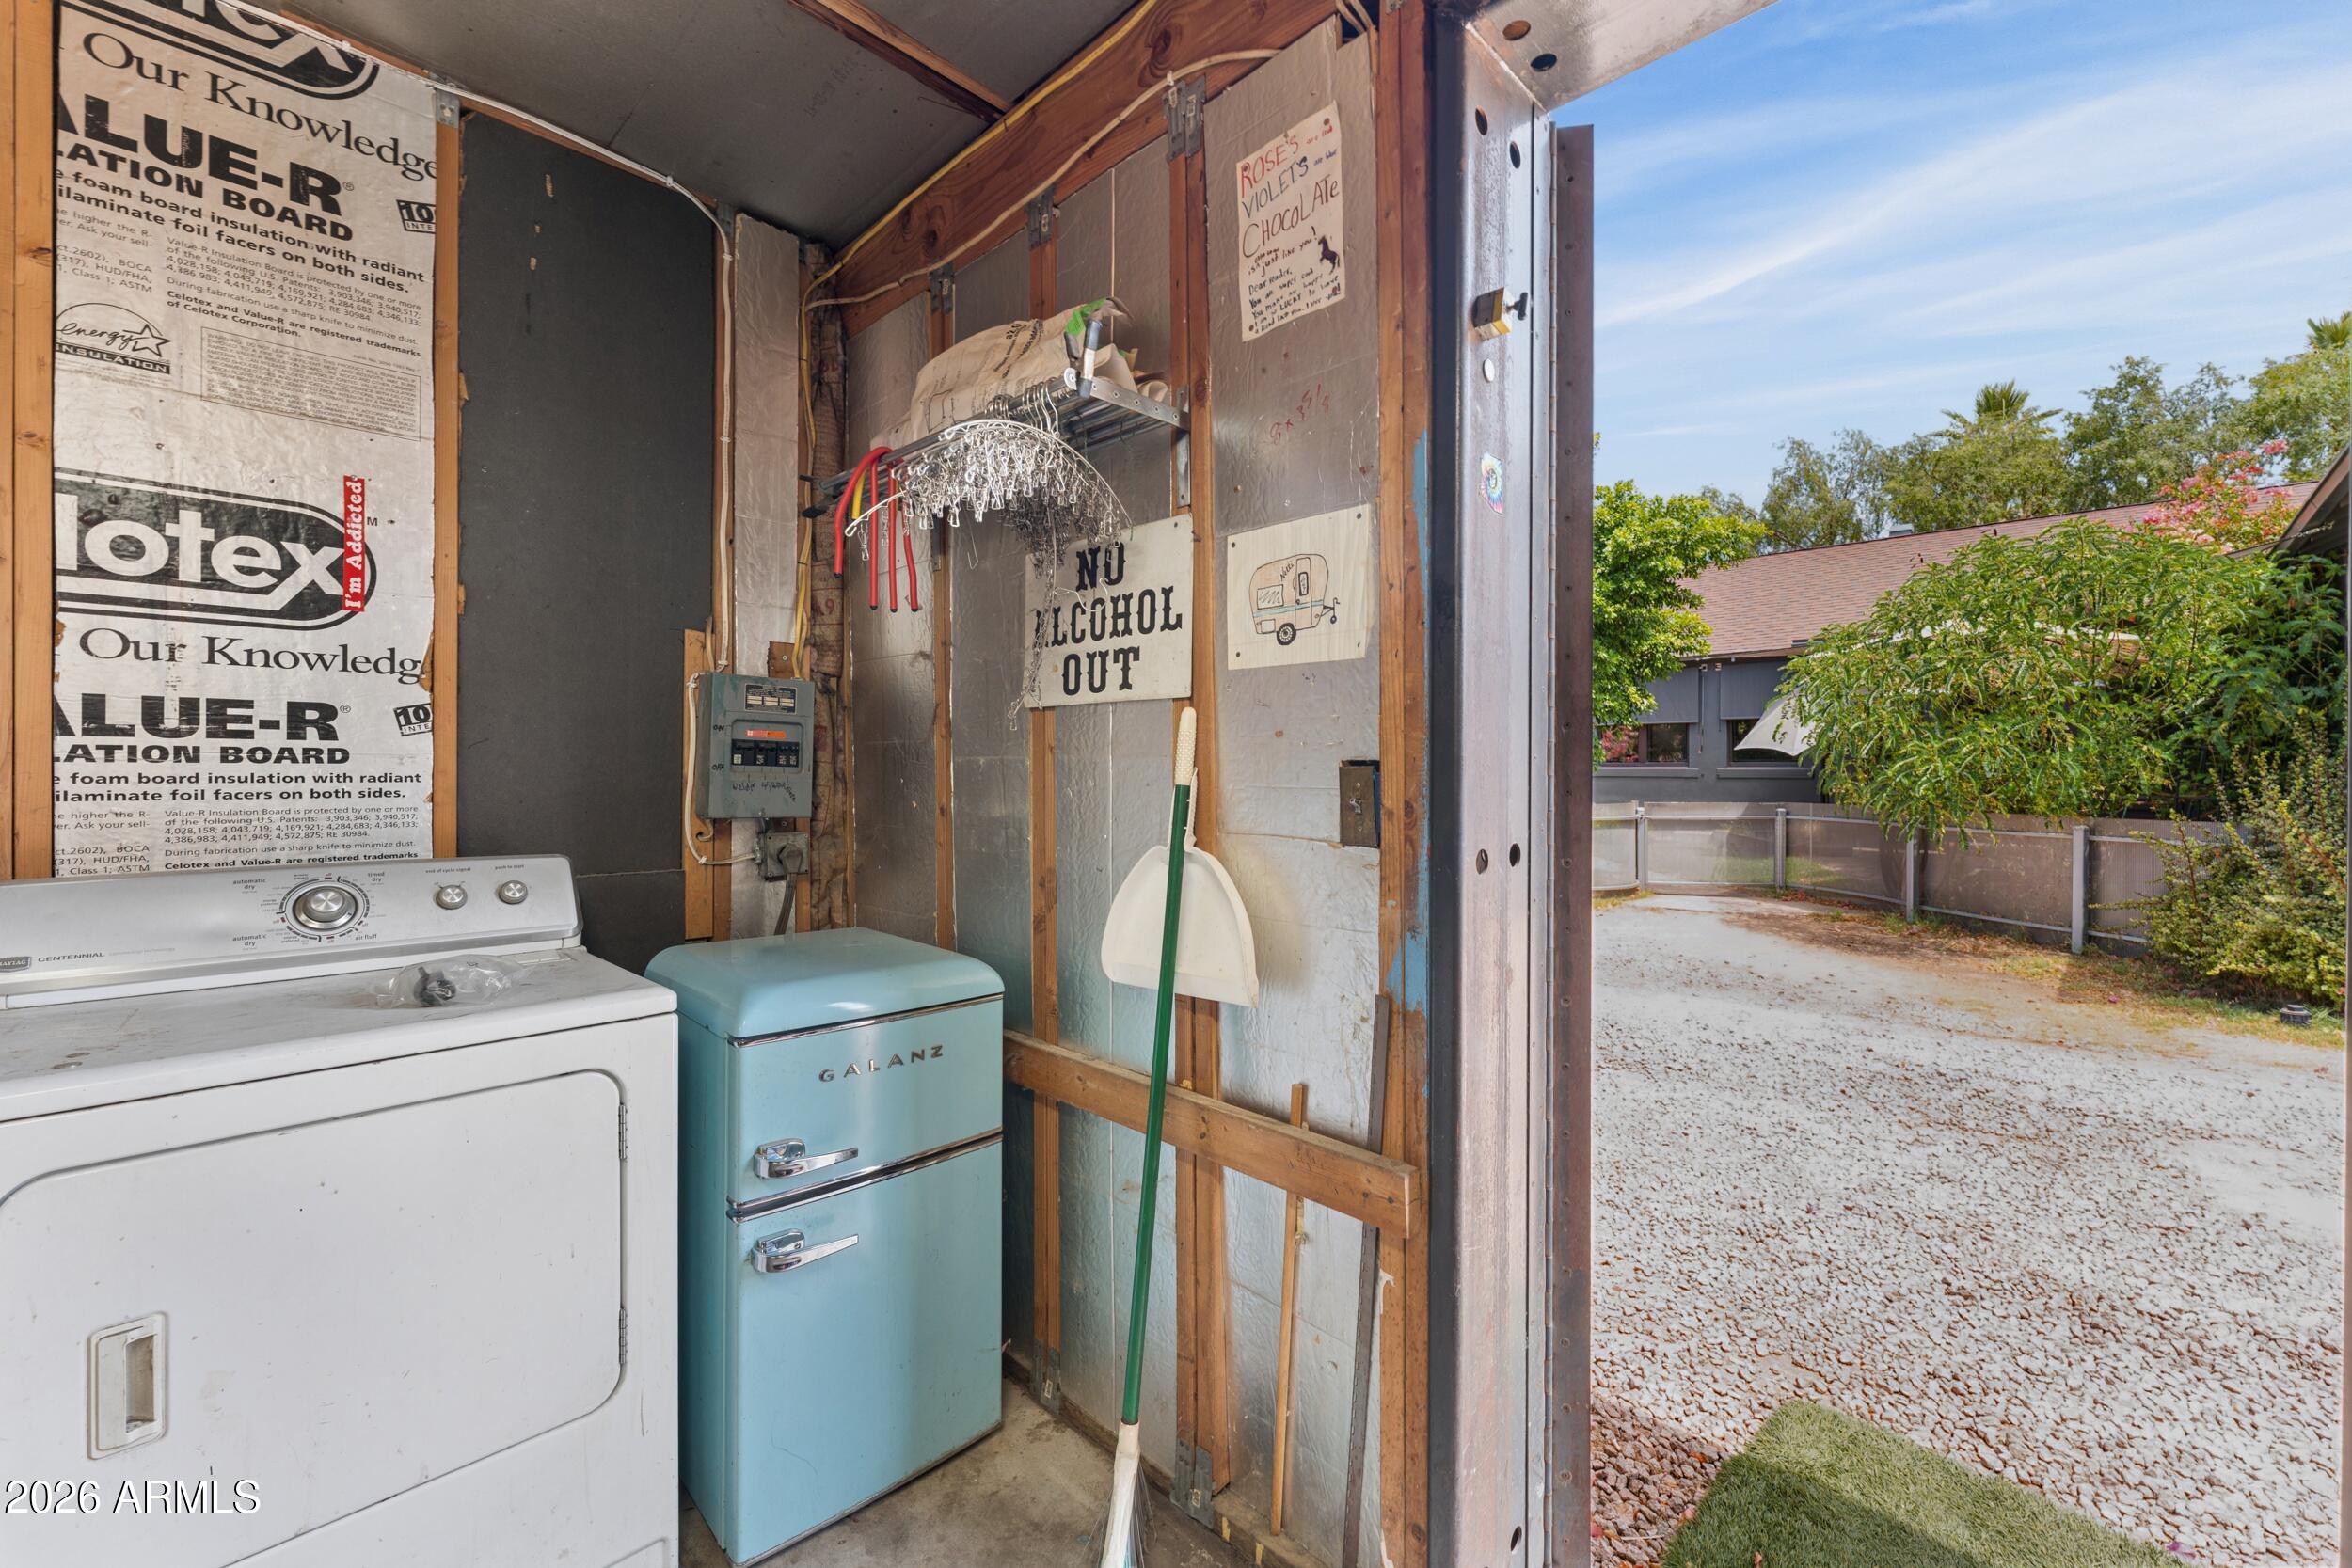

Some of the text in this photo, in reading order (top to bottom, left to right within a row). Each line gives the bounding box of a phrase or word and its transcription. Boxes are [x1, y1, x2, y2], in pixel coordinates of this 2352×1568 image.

[83, 32, 189, 91] Our
[204, 71, 437, 182] Knowledge
[58, 141, 353, 242] ATION BOARD
[73, 171, 424, 282] foam board insulation with radiant
[171, 217, 207, 237] foil
[215, 230, 275, 255] facers
[281, 251, 305, 263] on
[312, 256, 354, 277] both
[360, 272, 408, 293] sides.
[167, 290, 421, 356] Celotex and Value-R are registered trademarks
[183, 304, 228, 320] Celotex
[230, 315, 300, 337] Corporation.
[56, 323, 133, 350] energy
[56, 343, 167, 373] INSULATION
[344, 478, 364, 609] I'm Addicted
[1076, 541, 1126, 592] NO
[79, 627, 186, 663] Our
[1061, 646, 1139, 696] OUT
[396, 705, 431, 725] 10
[219, 746, 350, 765] BOARD
[70, 772, 421, 784] foam board insulation with radiant
[56, 789, 162, 801] ilaminate
[169, 788, 204, 800] foil
[213, 788, 272, 800] facers
[310, 787, 351, 799] both
[358, 787, 405, 798] sides.
[71, 811, 112, 820] higher
[202, 816, 252, 825] following
[256, 816, 275, 825] U.S.
[303, 806, 348, 816] protected
[351, 806, 361, 815] by
[98, 822, 124, 831] your
[165, 847, 199, 857] During
[203, 846, 257, 854] fabrication
[287, 844, 313, 852] sharp
[307, 853, 358, 864] registered
[362, 851, 418, 862] trademarks
[38, 952, 105, 963] CENTENNIAL
[818, 1045, 944, 1083] GALANZ
